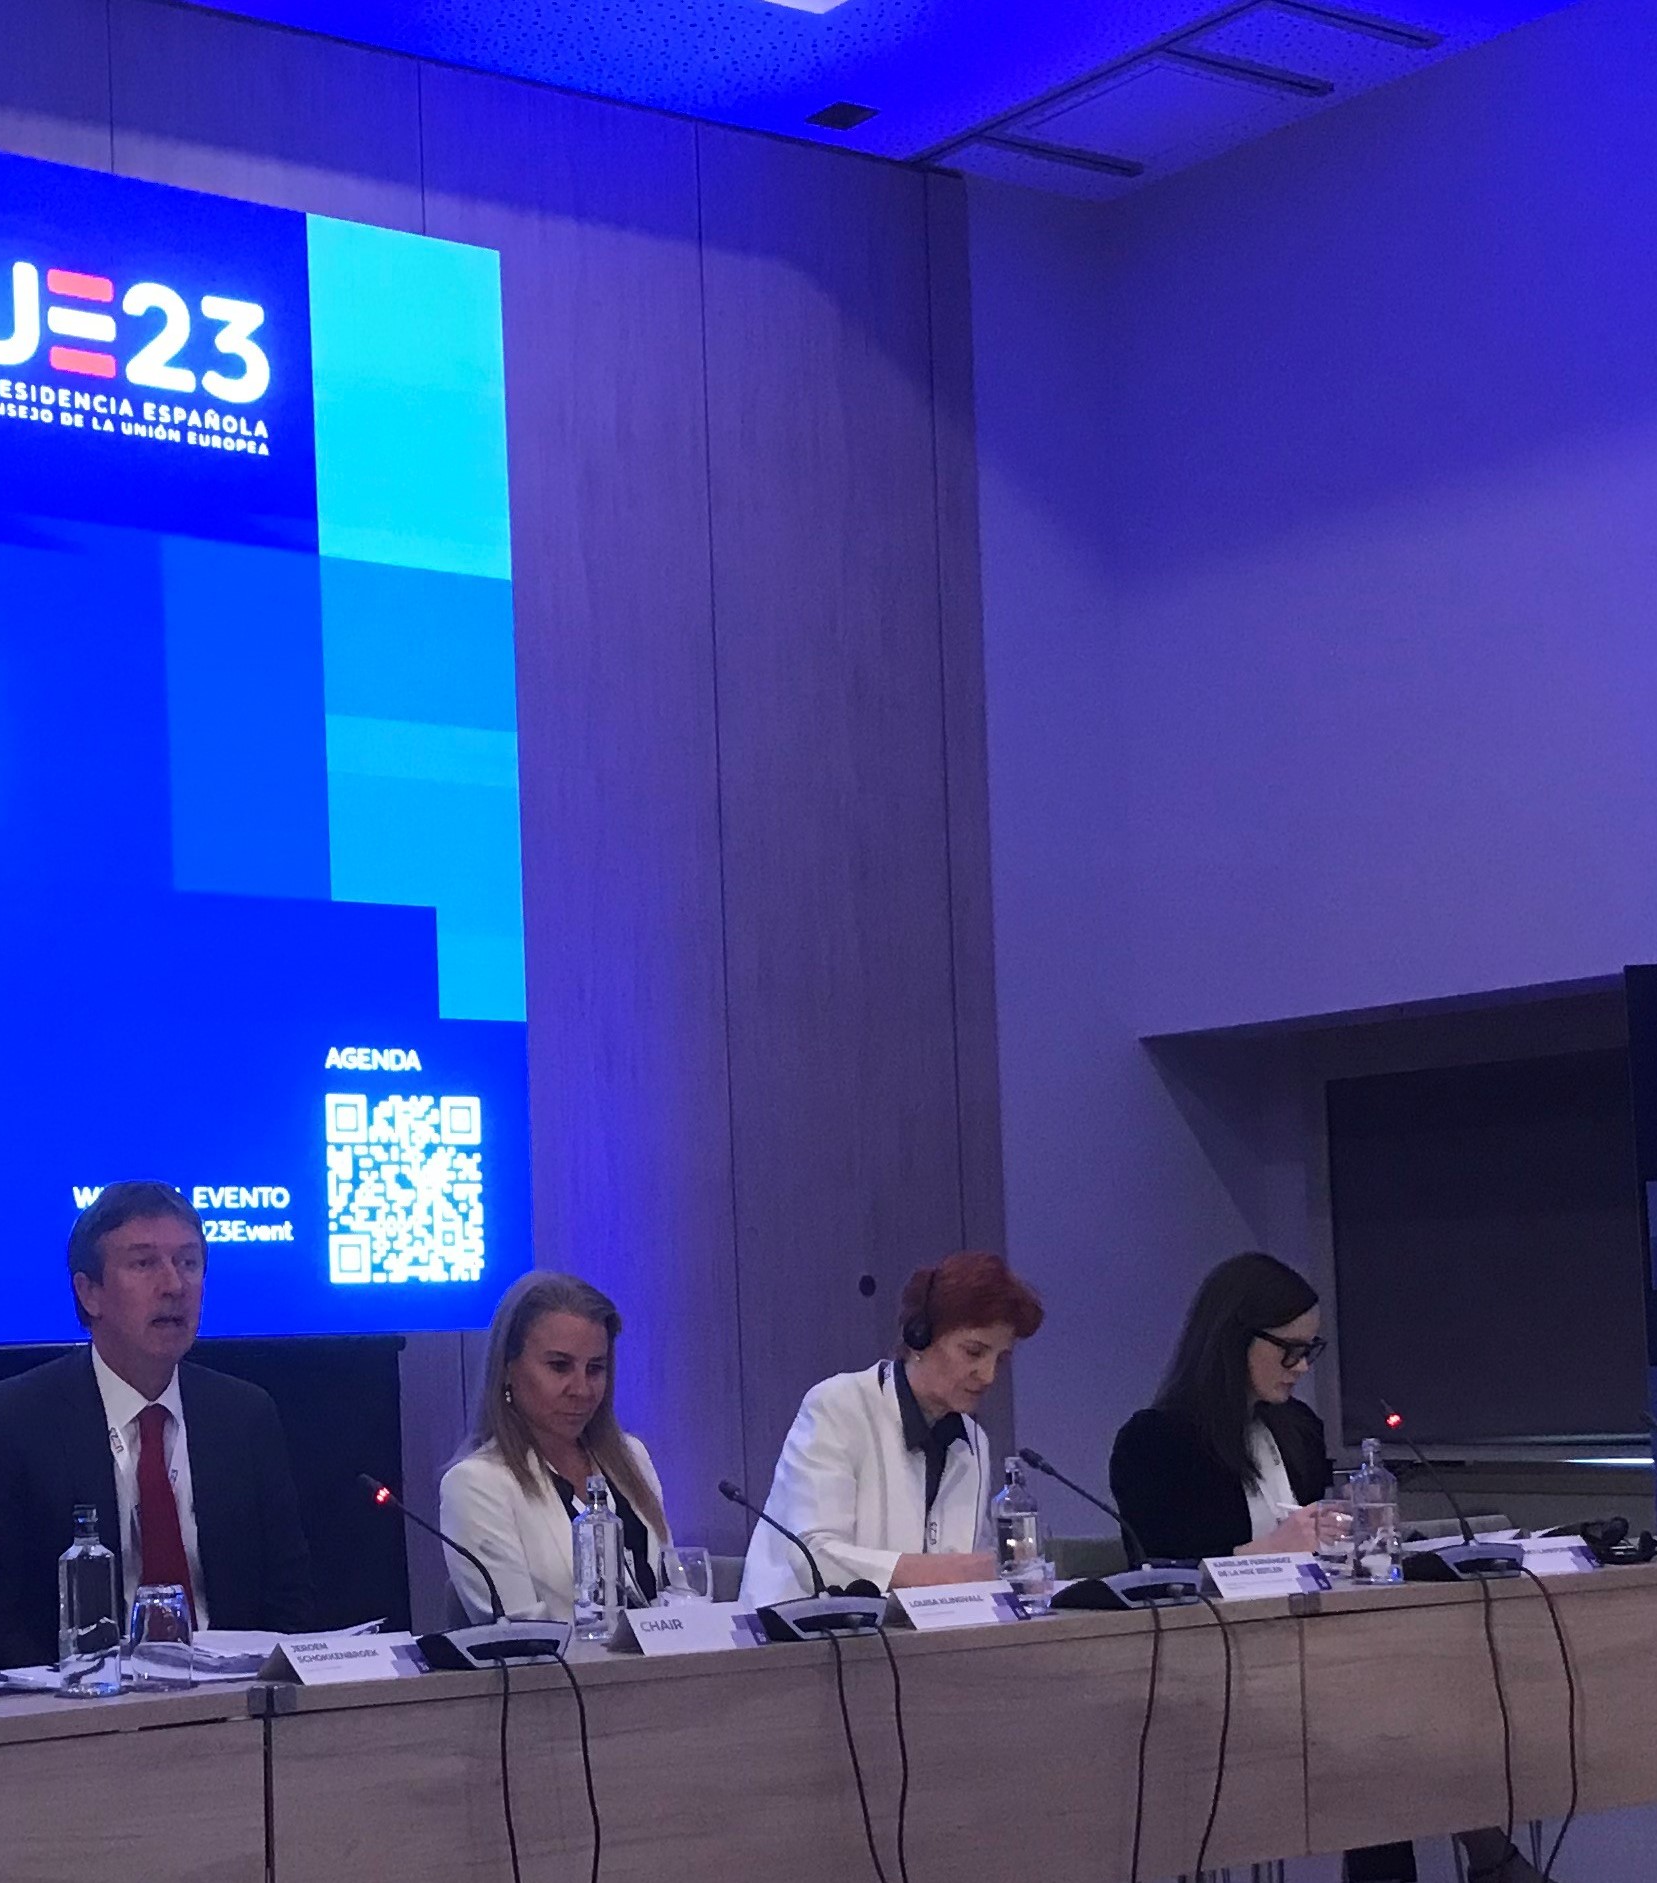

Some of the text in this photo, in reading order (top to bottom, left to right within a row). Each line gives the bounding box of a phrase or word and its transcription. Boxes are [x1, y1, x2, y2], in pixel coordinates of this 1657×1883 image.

[143, 402, 269, 439] ESPAÑOLA
[60, 411, 84, 428] DE
[91, 416, 115, 433] LA
[121, 421, 181, 443] UNIÓN
[187, 431, 269, 456] EUROPEA
[324, 1046, 422, 1072] AGENDA
[192, 1186, 290, 1209] EVENTO
[202, 1220, 295, 1242] 23Event
[639, 1618, 684, 1633] CHAIR
